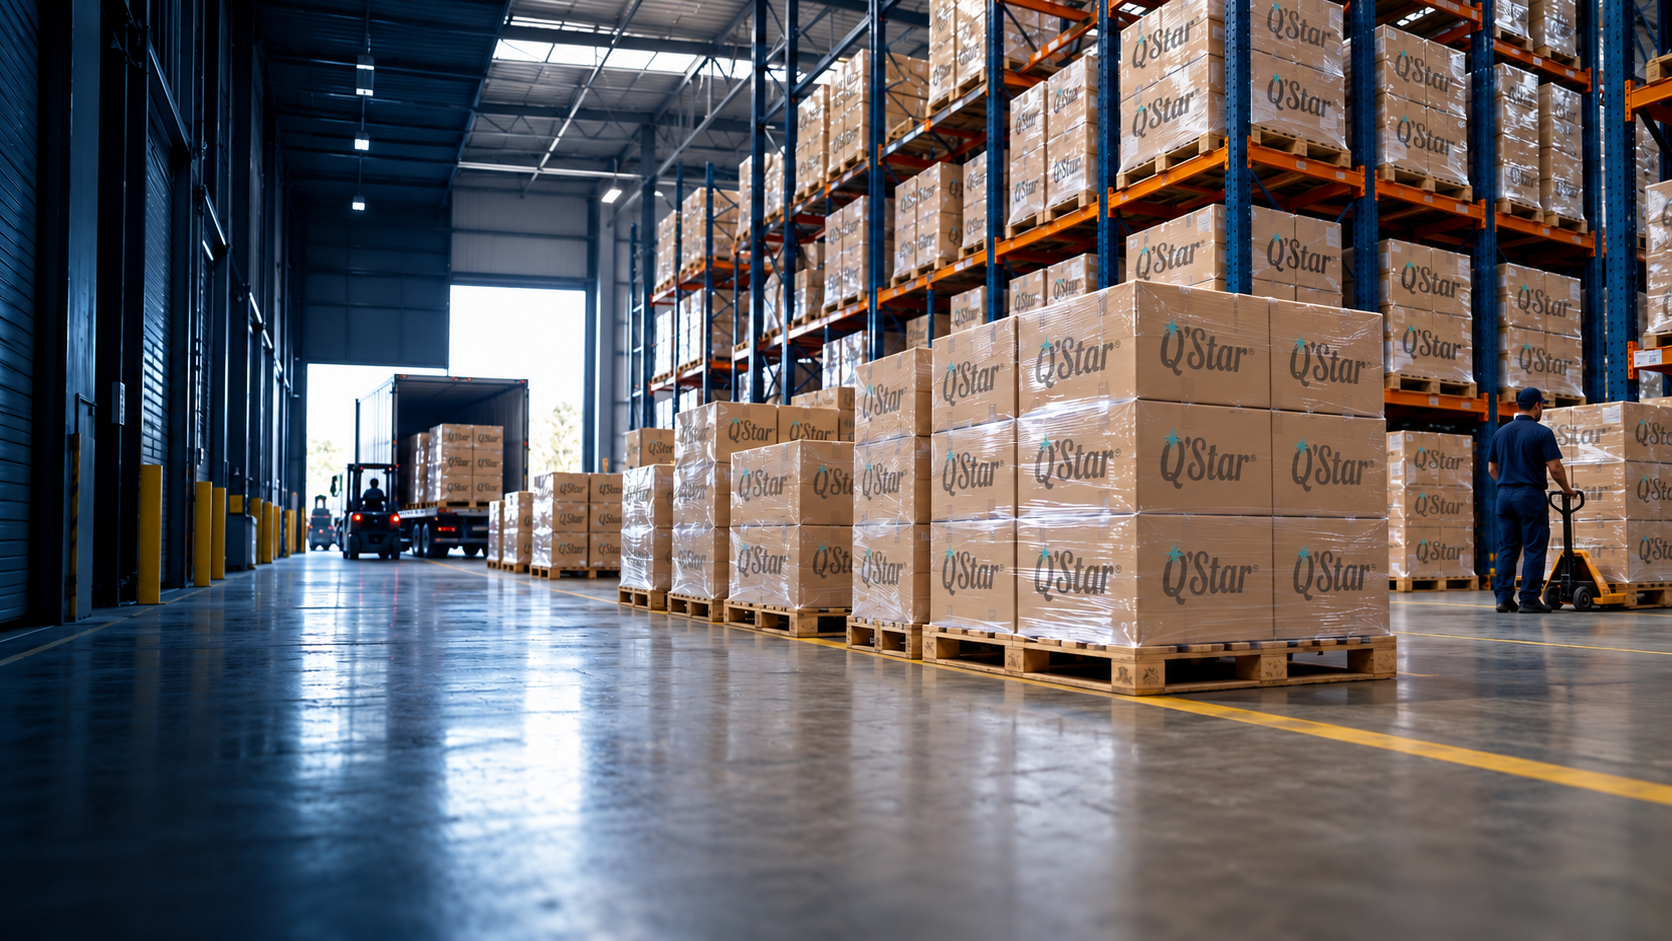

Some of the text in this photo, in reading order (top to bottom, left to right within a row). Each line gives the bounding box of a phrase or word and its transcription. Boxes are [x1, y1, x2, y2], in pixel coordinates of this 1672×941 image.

[1267, 8, 1331, 48] Q'Star
[1395, 53, 1452, 92] Q'Star
[1267, 78, 1331, 118] Q'Star
[1397, 119, 1454, 156] Q'Star
[1401, 265, 1460, 299] Q'Star
[1517, 287, 1571, 318] Q'Star
[1403, 329, 1461, 360] Q'Star
[1519, 347, 1572, 376] Q'Star
[1414, 449, 1464, 471] Q'Star
[1414, 494, 1465, 517] Q'Star
[1416, 540, 1464, 564] Q'Star
